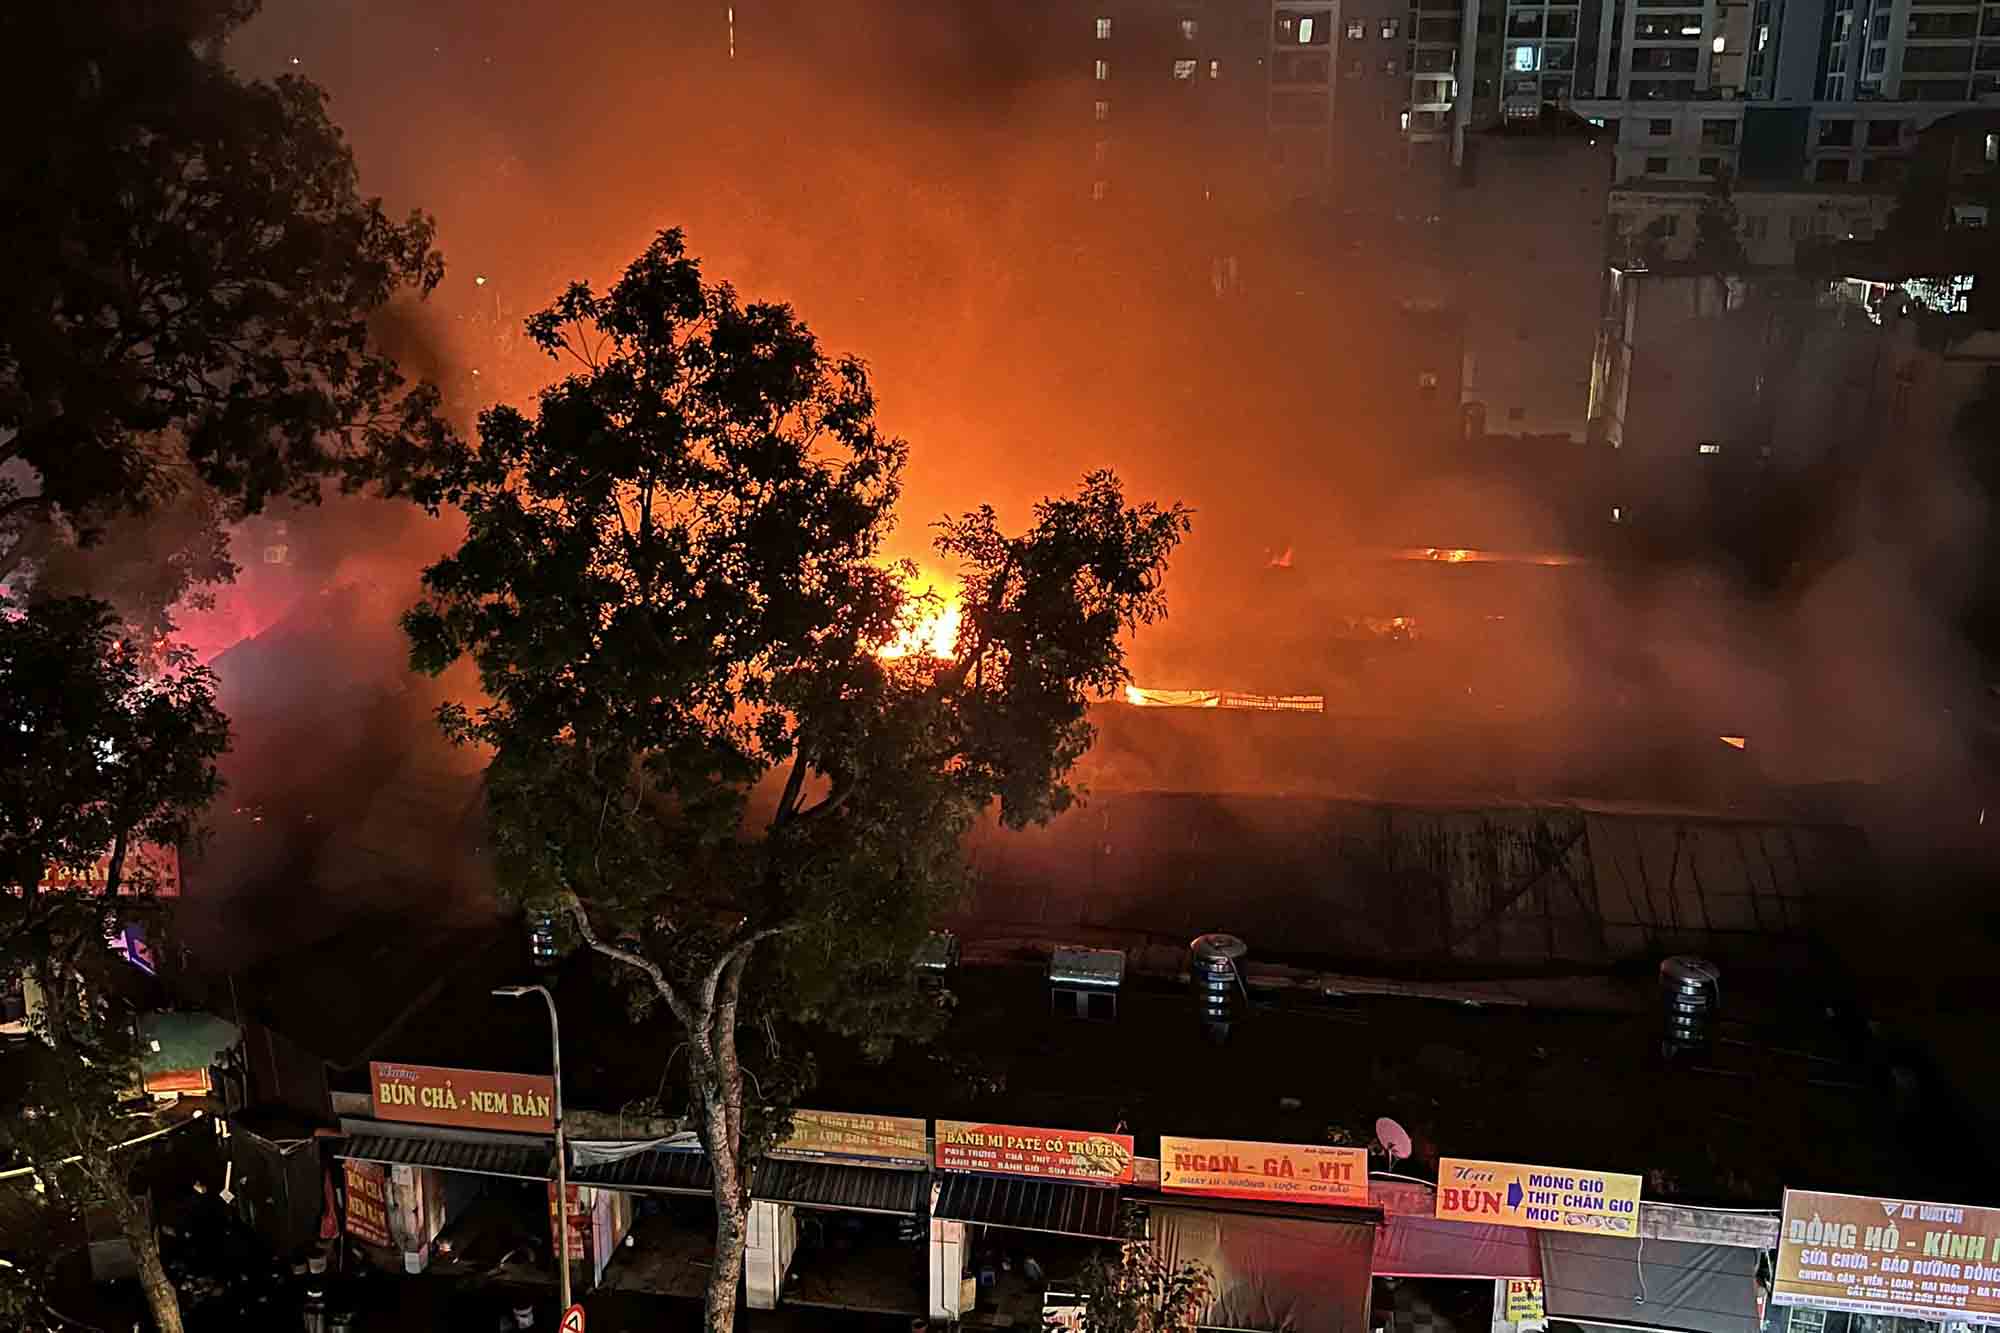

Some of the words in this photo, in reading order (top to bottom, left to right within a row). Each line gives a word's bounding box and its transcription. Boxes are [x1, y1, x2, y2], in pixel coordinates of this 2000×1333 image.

[380, 1079, 416, 1105] BÚN
[421, 1080, 457, 1110] CHẢ
[470, 1091, 507, 1114] NEM
[512, 1089, 550, 1117] RÁN
[945, 1129, 984, 1146] BÁNH
[988, 1133, 1003, 1147] MÌ
[1045, 1136, 1064, 1152] CỔ
[1174, 1153, 1239, 1172] NGAN
[1263, 1155, 1295, 1177] GÀ
[1318, 1161, 1353, 1183] VỊT
[1442, 1184, 1502, 1215] BÚN
[1528, 1190, 1559, 1206] THỊT
[1563, 1193, 1604, 1210] CHÂN
[1919, 1205, 1964, 1224] WATCH
[1526, 1207, 1559, 1223] MỌC
[1789, 1211, 1857, 1248] ĐỒNG
[1864, 1219, 1899, 1253] HỒ
[1923, 1229, 1986, 1260] KÍNH
[1801, 1247, 1828, 1266] SỬA
[1831, 1251, 1868, 1270] CHỮA
[1881, 1255, 1910, 1273] BẢO
[1912, 1257, 1961, 1279] DƯỠNG
